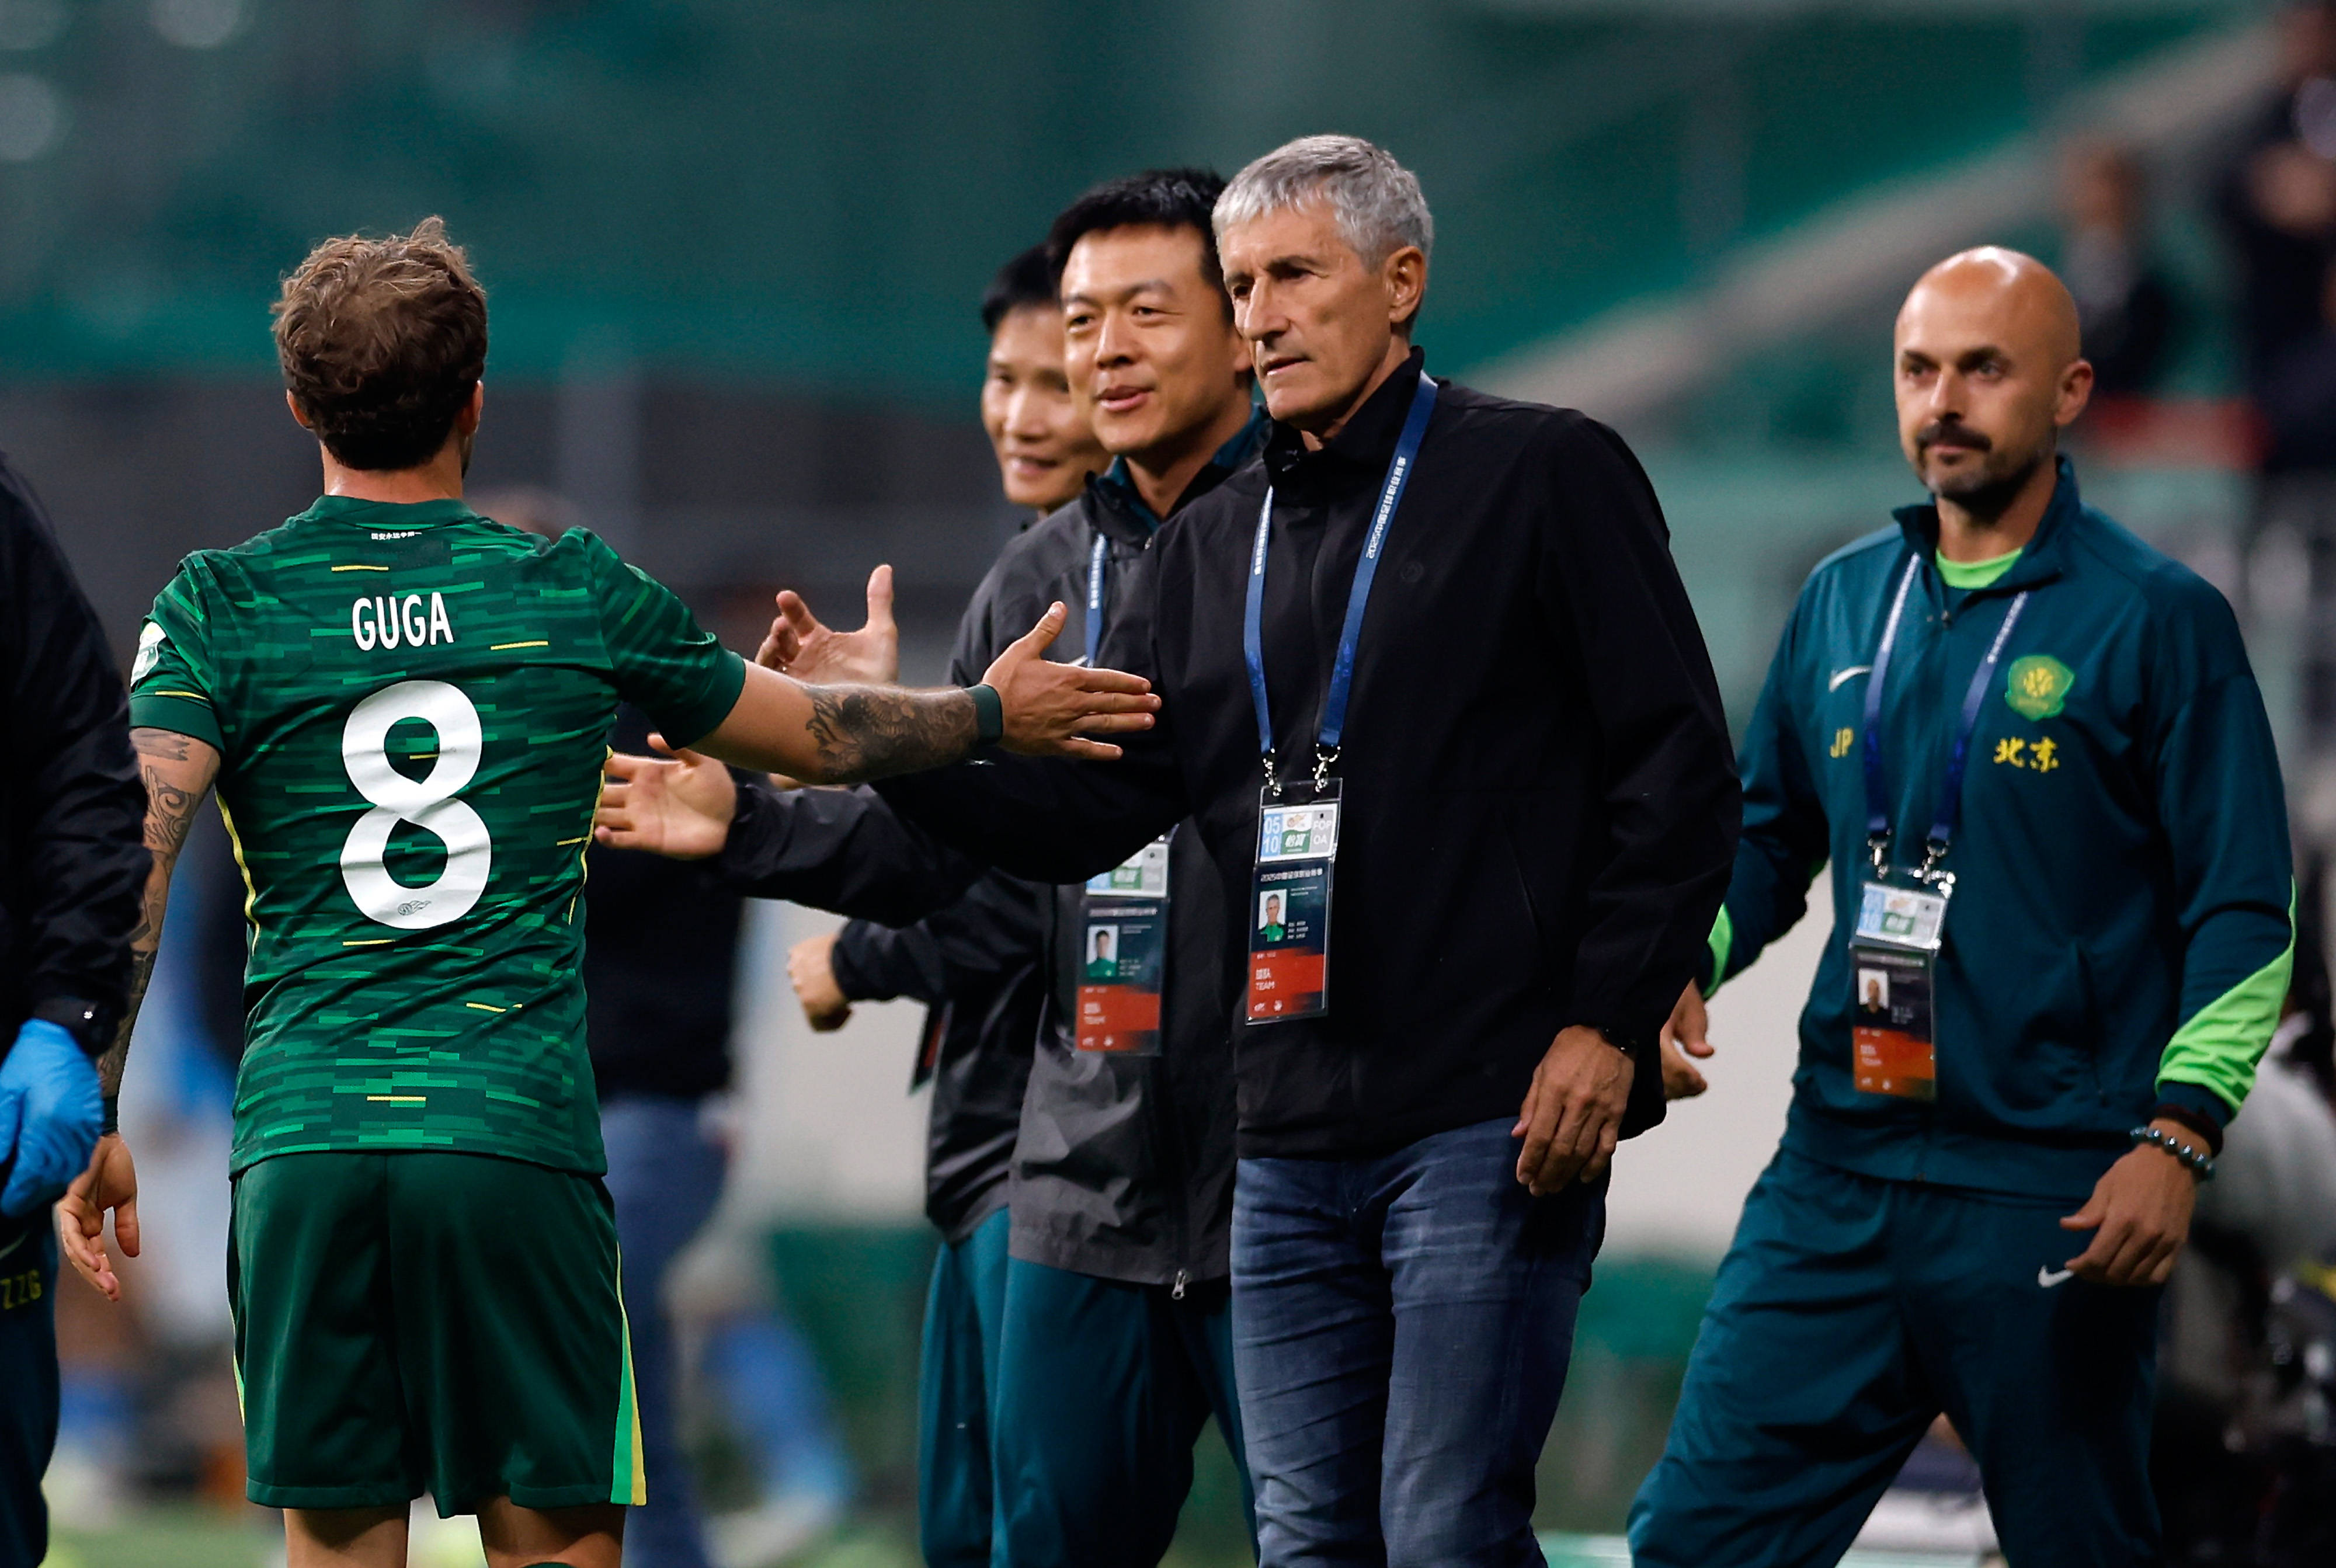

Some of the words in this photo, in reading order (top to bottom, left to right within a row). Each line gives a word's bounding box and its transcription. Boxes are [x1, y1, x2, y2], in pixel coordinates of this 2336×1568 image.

[352, 591, 454, 651] GUGA
[1830, 727, 1854, 759] JP
[1993, 736, 2060, 773] 北京
[340, 680, 491, 930] 8
[1264, 816, 1281, 834] 05
[1313, 819, 1333, 829] FOP
[1263, 836, 1279, 853] 10
[1313, 835, 1327, 844] OA
